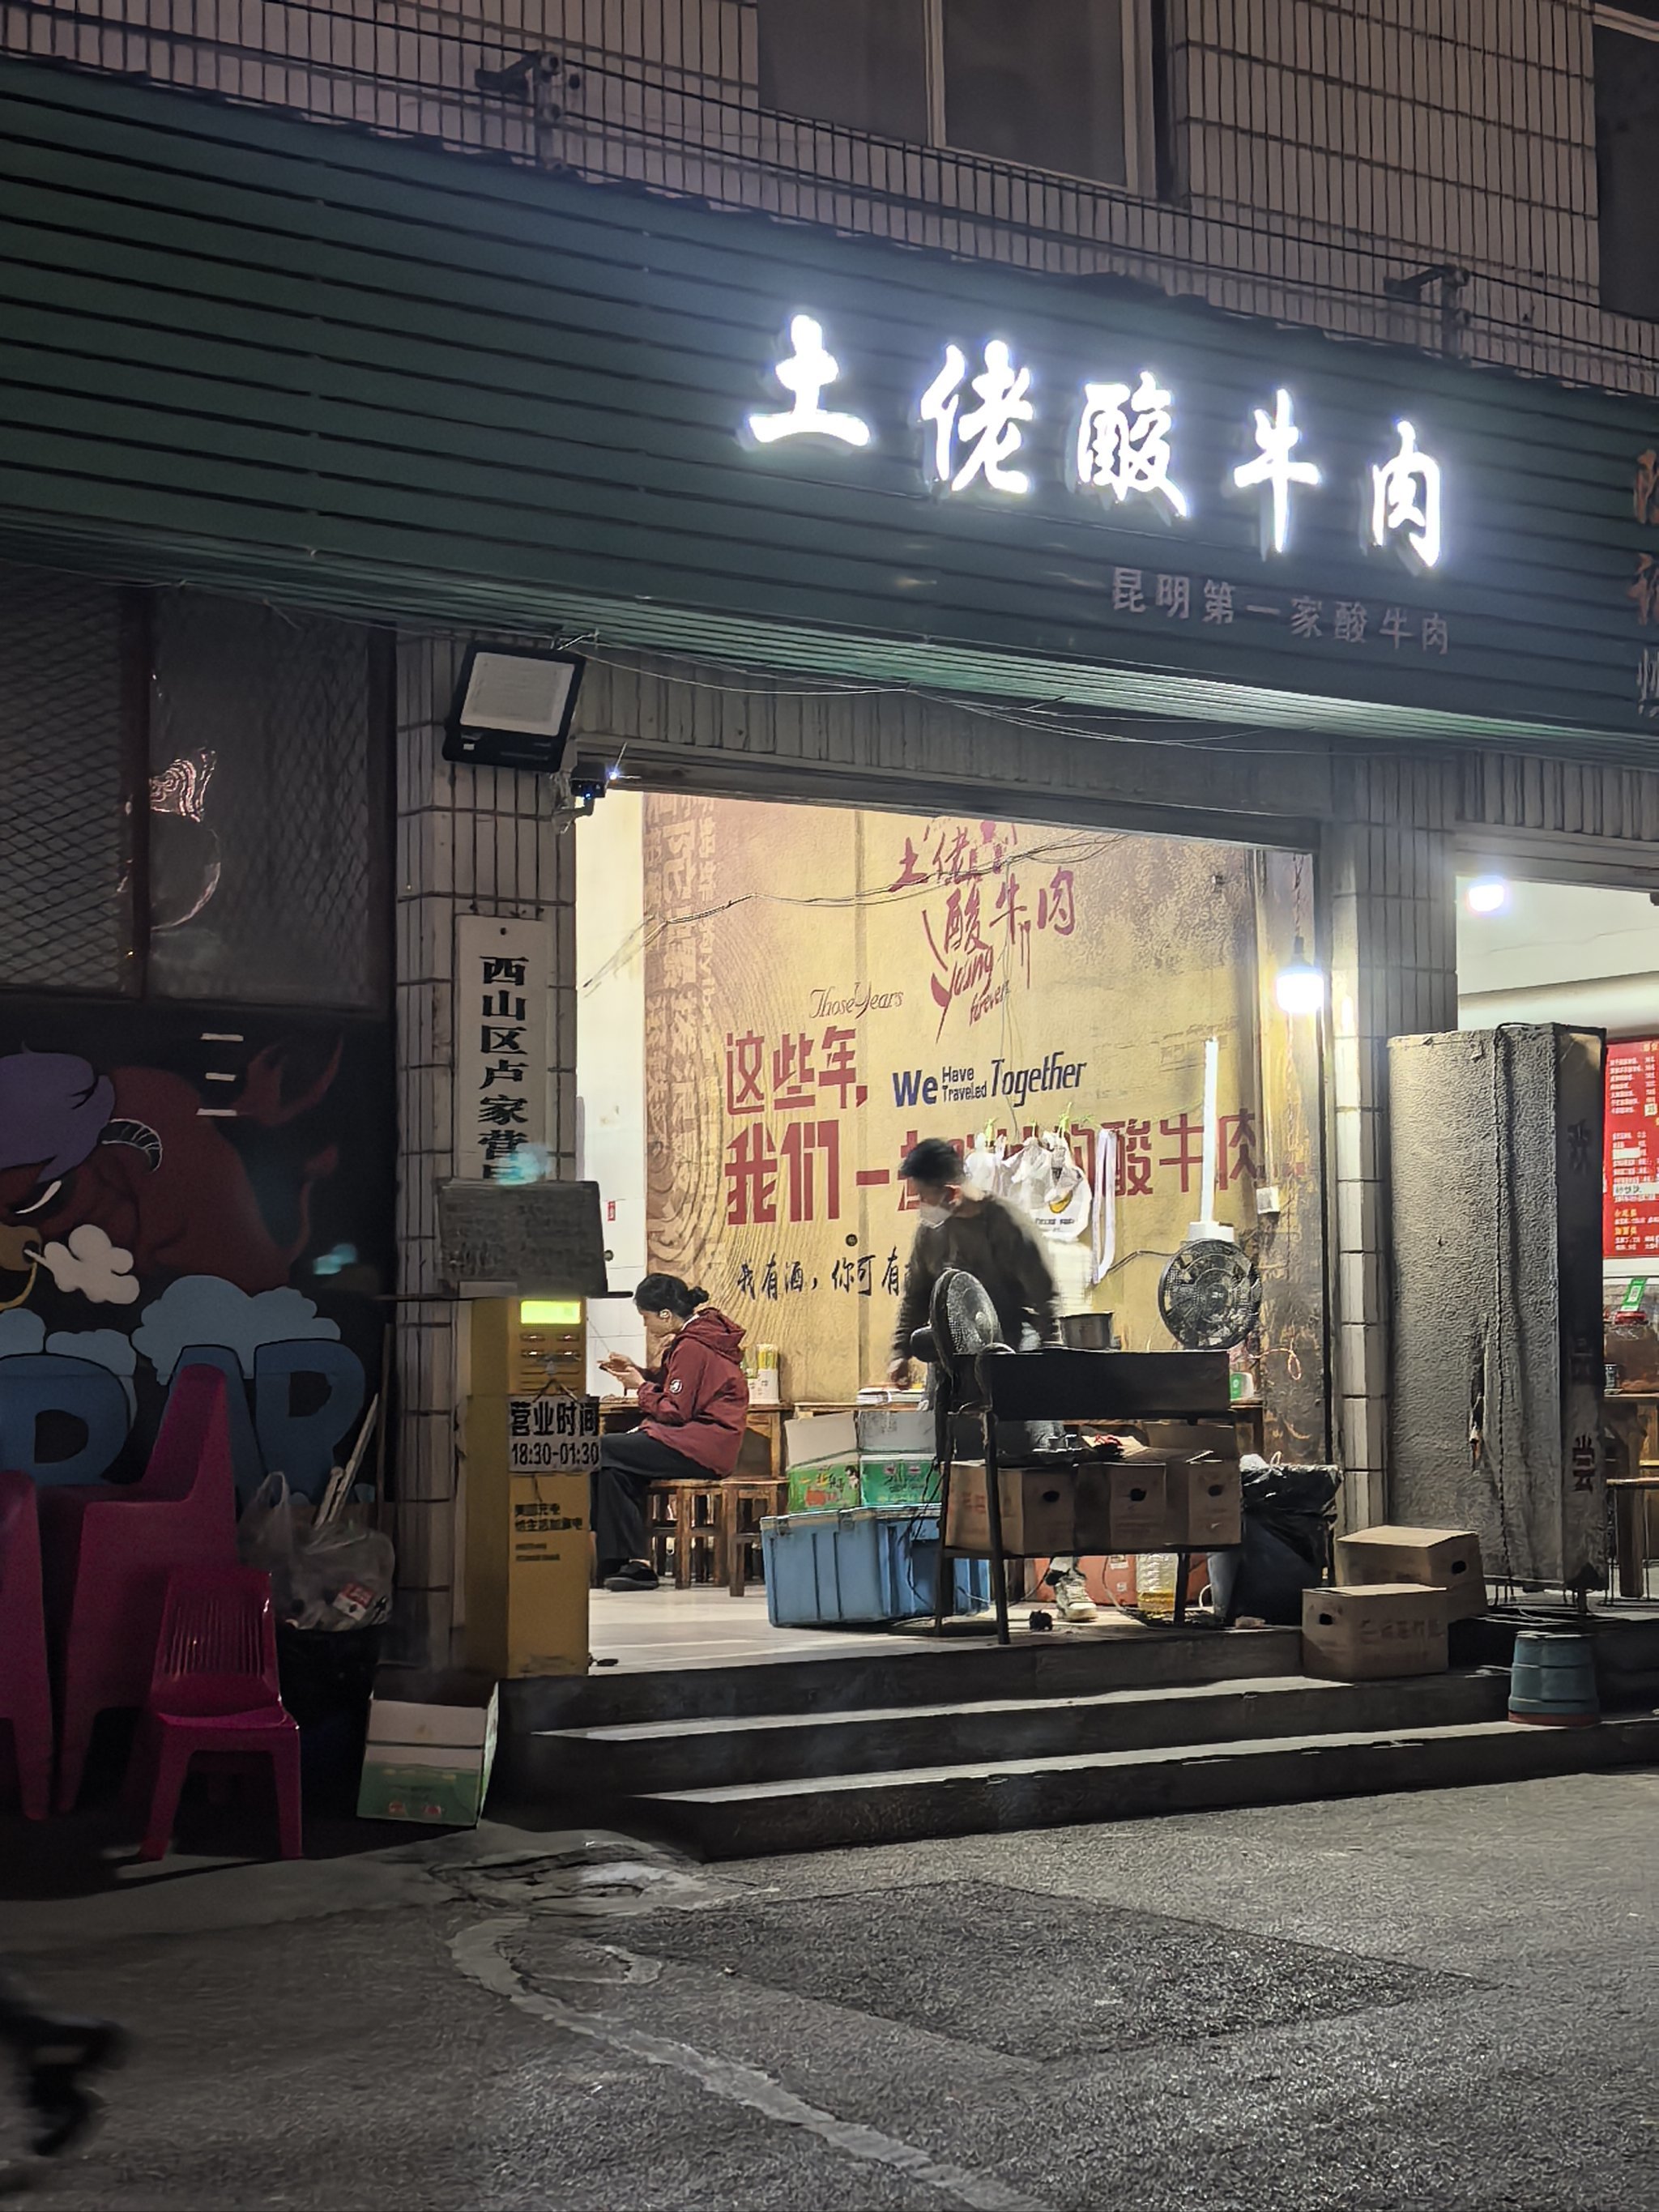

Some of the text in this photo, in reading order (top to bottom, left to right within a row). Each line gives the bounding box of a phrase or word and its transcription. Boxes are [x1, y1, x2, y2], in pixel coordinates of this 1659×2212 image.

[748, 313, 1444, 568] 土佬酸牛肉
[1112, 566, 1449, 654] 昆明第一家酸牛肉
[809, 980, 904, 1020] Those Years
[893, 1051, 1087, 1107] We Have Traveled Together
[738, 1247, 910, 1300] 我有酒，你可有
[510, 1401, 599, 1436] 营业时间
[512, 1443, 599, 1465] 18:30-01:30
